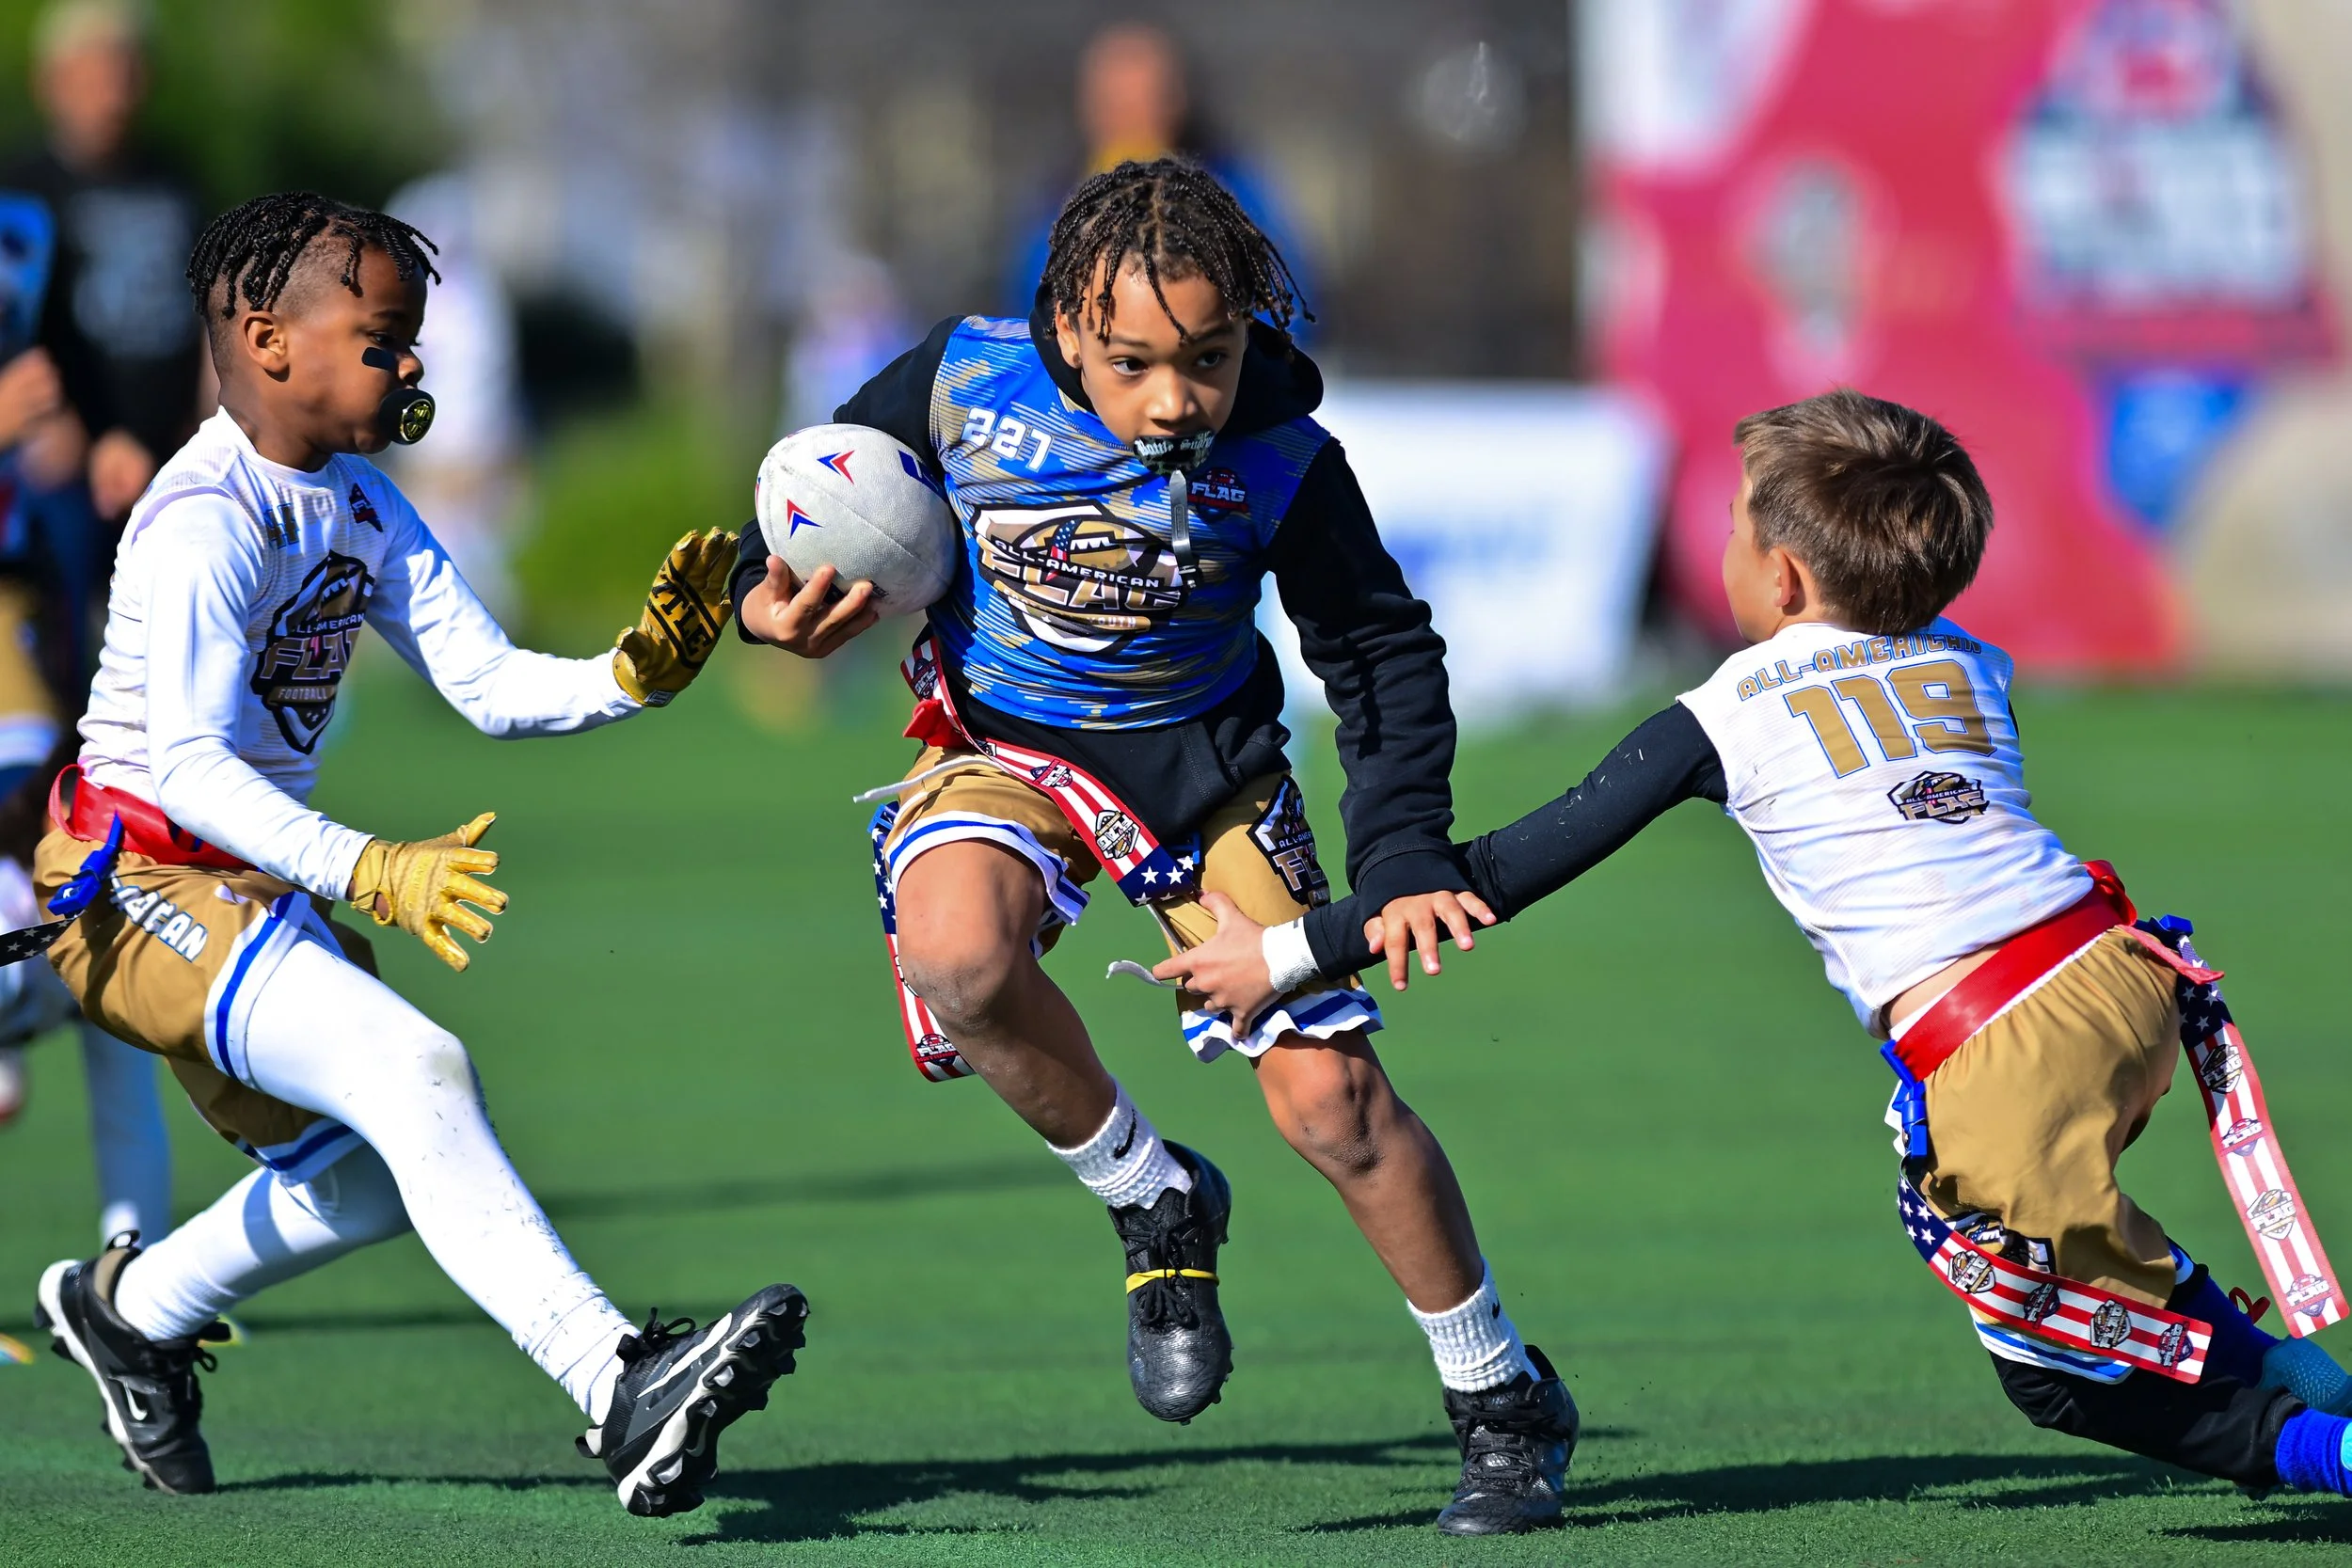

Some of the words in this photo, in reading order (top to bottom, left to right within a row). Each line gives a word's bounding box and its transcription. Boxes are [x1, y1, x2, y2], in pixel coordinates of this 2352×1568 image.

[961, 405, 1054, 472] 227
[1191, 481, 1246, 502] FLAG
[979, 551, 1182, 611] FLAG
[994, 539, 1160, 588] ALL-AMERICAN
[293, 612, 368, 635] LL-AMERICAN
[1738, 634, 1982, 701] ALL-AMERICAN
[278, 687, 327, 700] FOOTBALL
[1783, 659, 1997, 779] 119
[1899, 791, 1987, 821] FLAG
[1096, 814, 1134, 852] FLAG
[916, 1042, 956, 1057] FLAG
[2202, 1053, 2243, 1087] FLAG
[2249, 1200, 2296, 1232] FLAG
[1956, 1256, 1990, 1292] FLAG
[2098, 1303, 2125, 1349] FLAG
